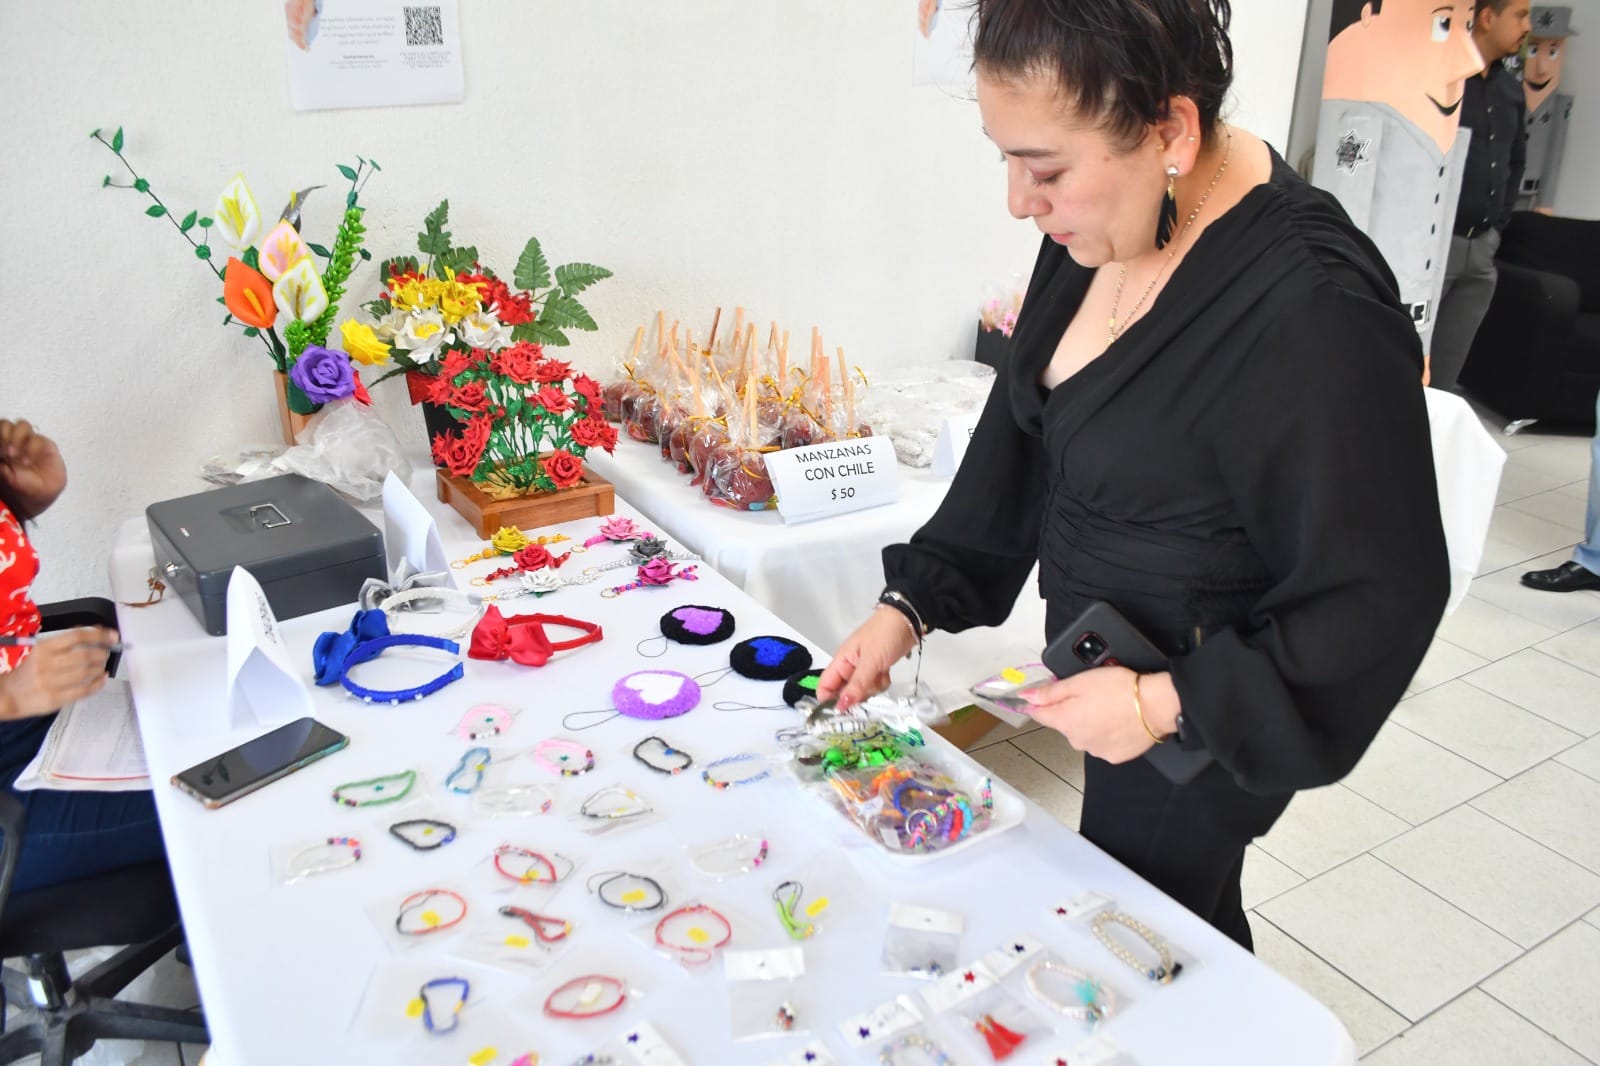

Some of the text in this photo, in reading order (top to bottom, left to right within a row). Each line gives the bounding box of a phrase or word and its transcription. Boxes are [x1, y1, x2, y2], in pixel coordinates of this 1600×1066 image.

[795, 444, 873, 464] MANZANAS
[804, 461, 876, 481] CON CHILE
[840, 487, 856, 499] 50
